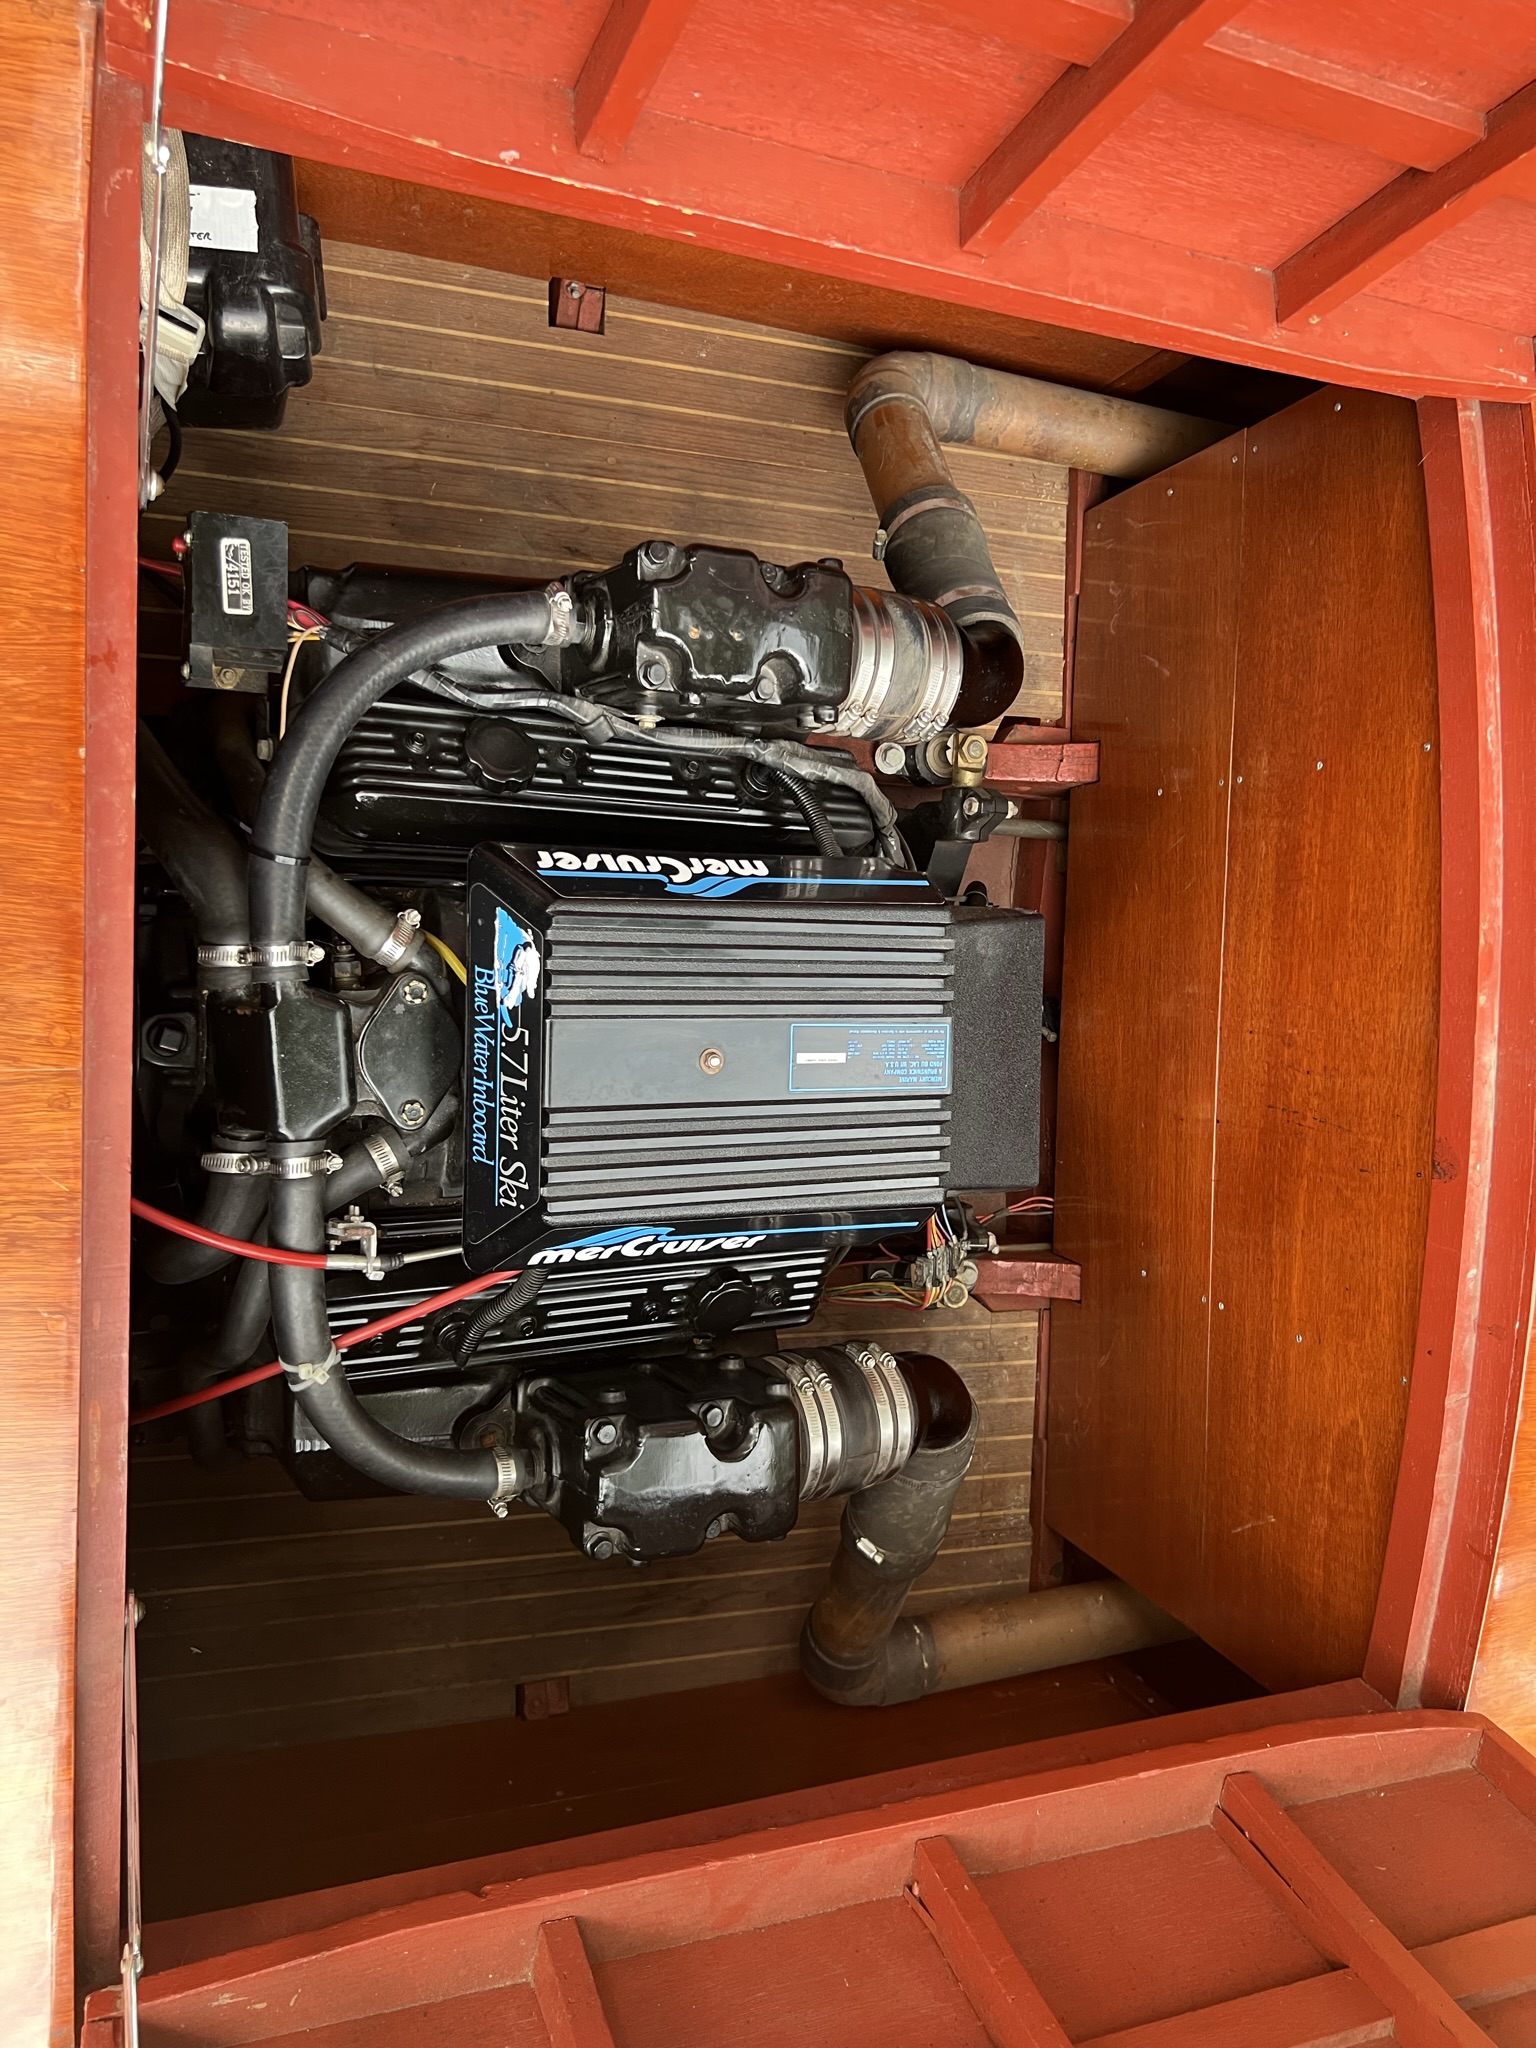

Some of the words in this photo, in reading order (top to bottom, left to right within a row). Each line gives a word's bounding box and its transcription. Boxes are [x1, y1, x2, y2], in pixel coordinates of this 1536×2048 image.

[240, 543, 250, 579] TESTED
[242, 582, 251, 595] OK
[242, 599, 251, 611] BY
[500, 1023, 529, 1074] 5.7
[499, 1072, 528, 1150] Liter
[499, 1156, 529, 1210] Ski
